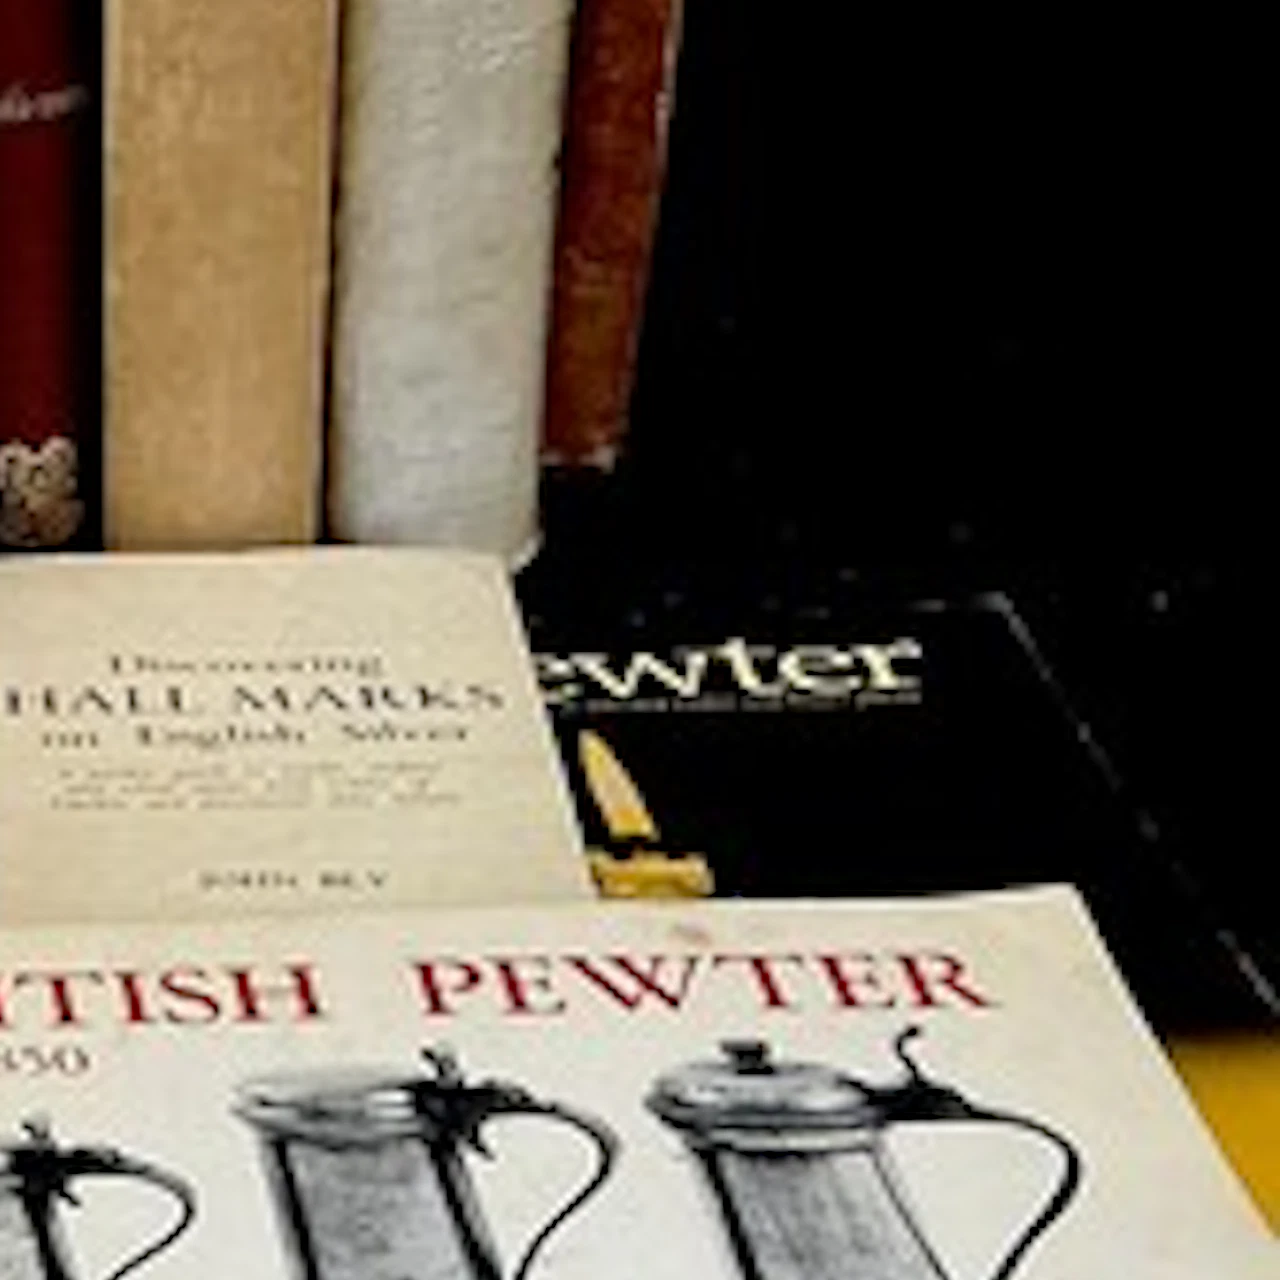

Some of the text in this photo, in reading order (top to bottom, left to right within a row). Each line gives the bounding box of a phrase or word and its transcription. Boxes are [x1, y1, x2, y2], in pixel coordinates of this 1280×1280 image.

[108, 651, 386, 681] Discovering
[4, 682, 506, 719] HALL MARKS
[41, 726, 100, 748] on
[138, 722, 309, 751] English
[412, 952, 1000, 1017] PEWTER
